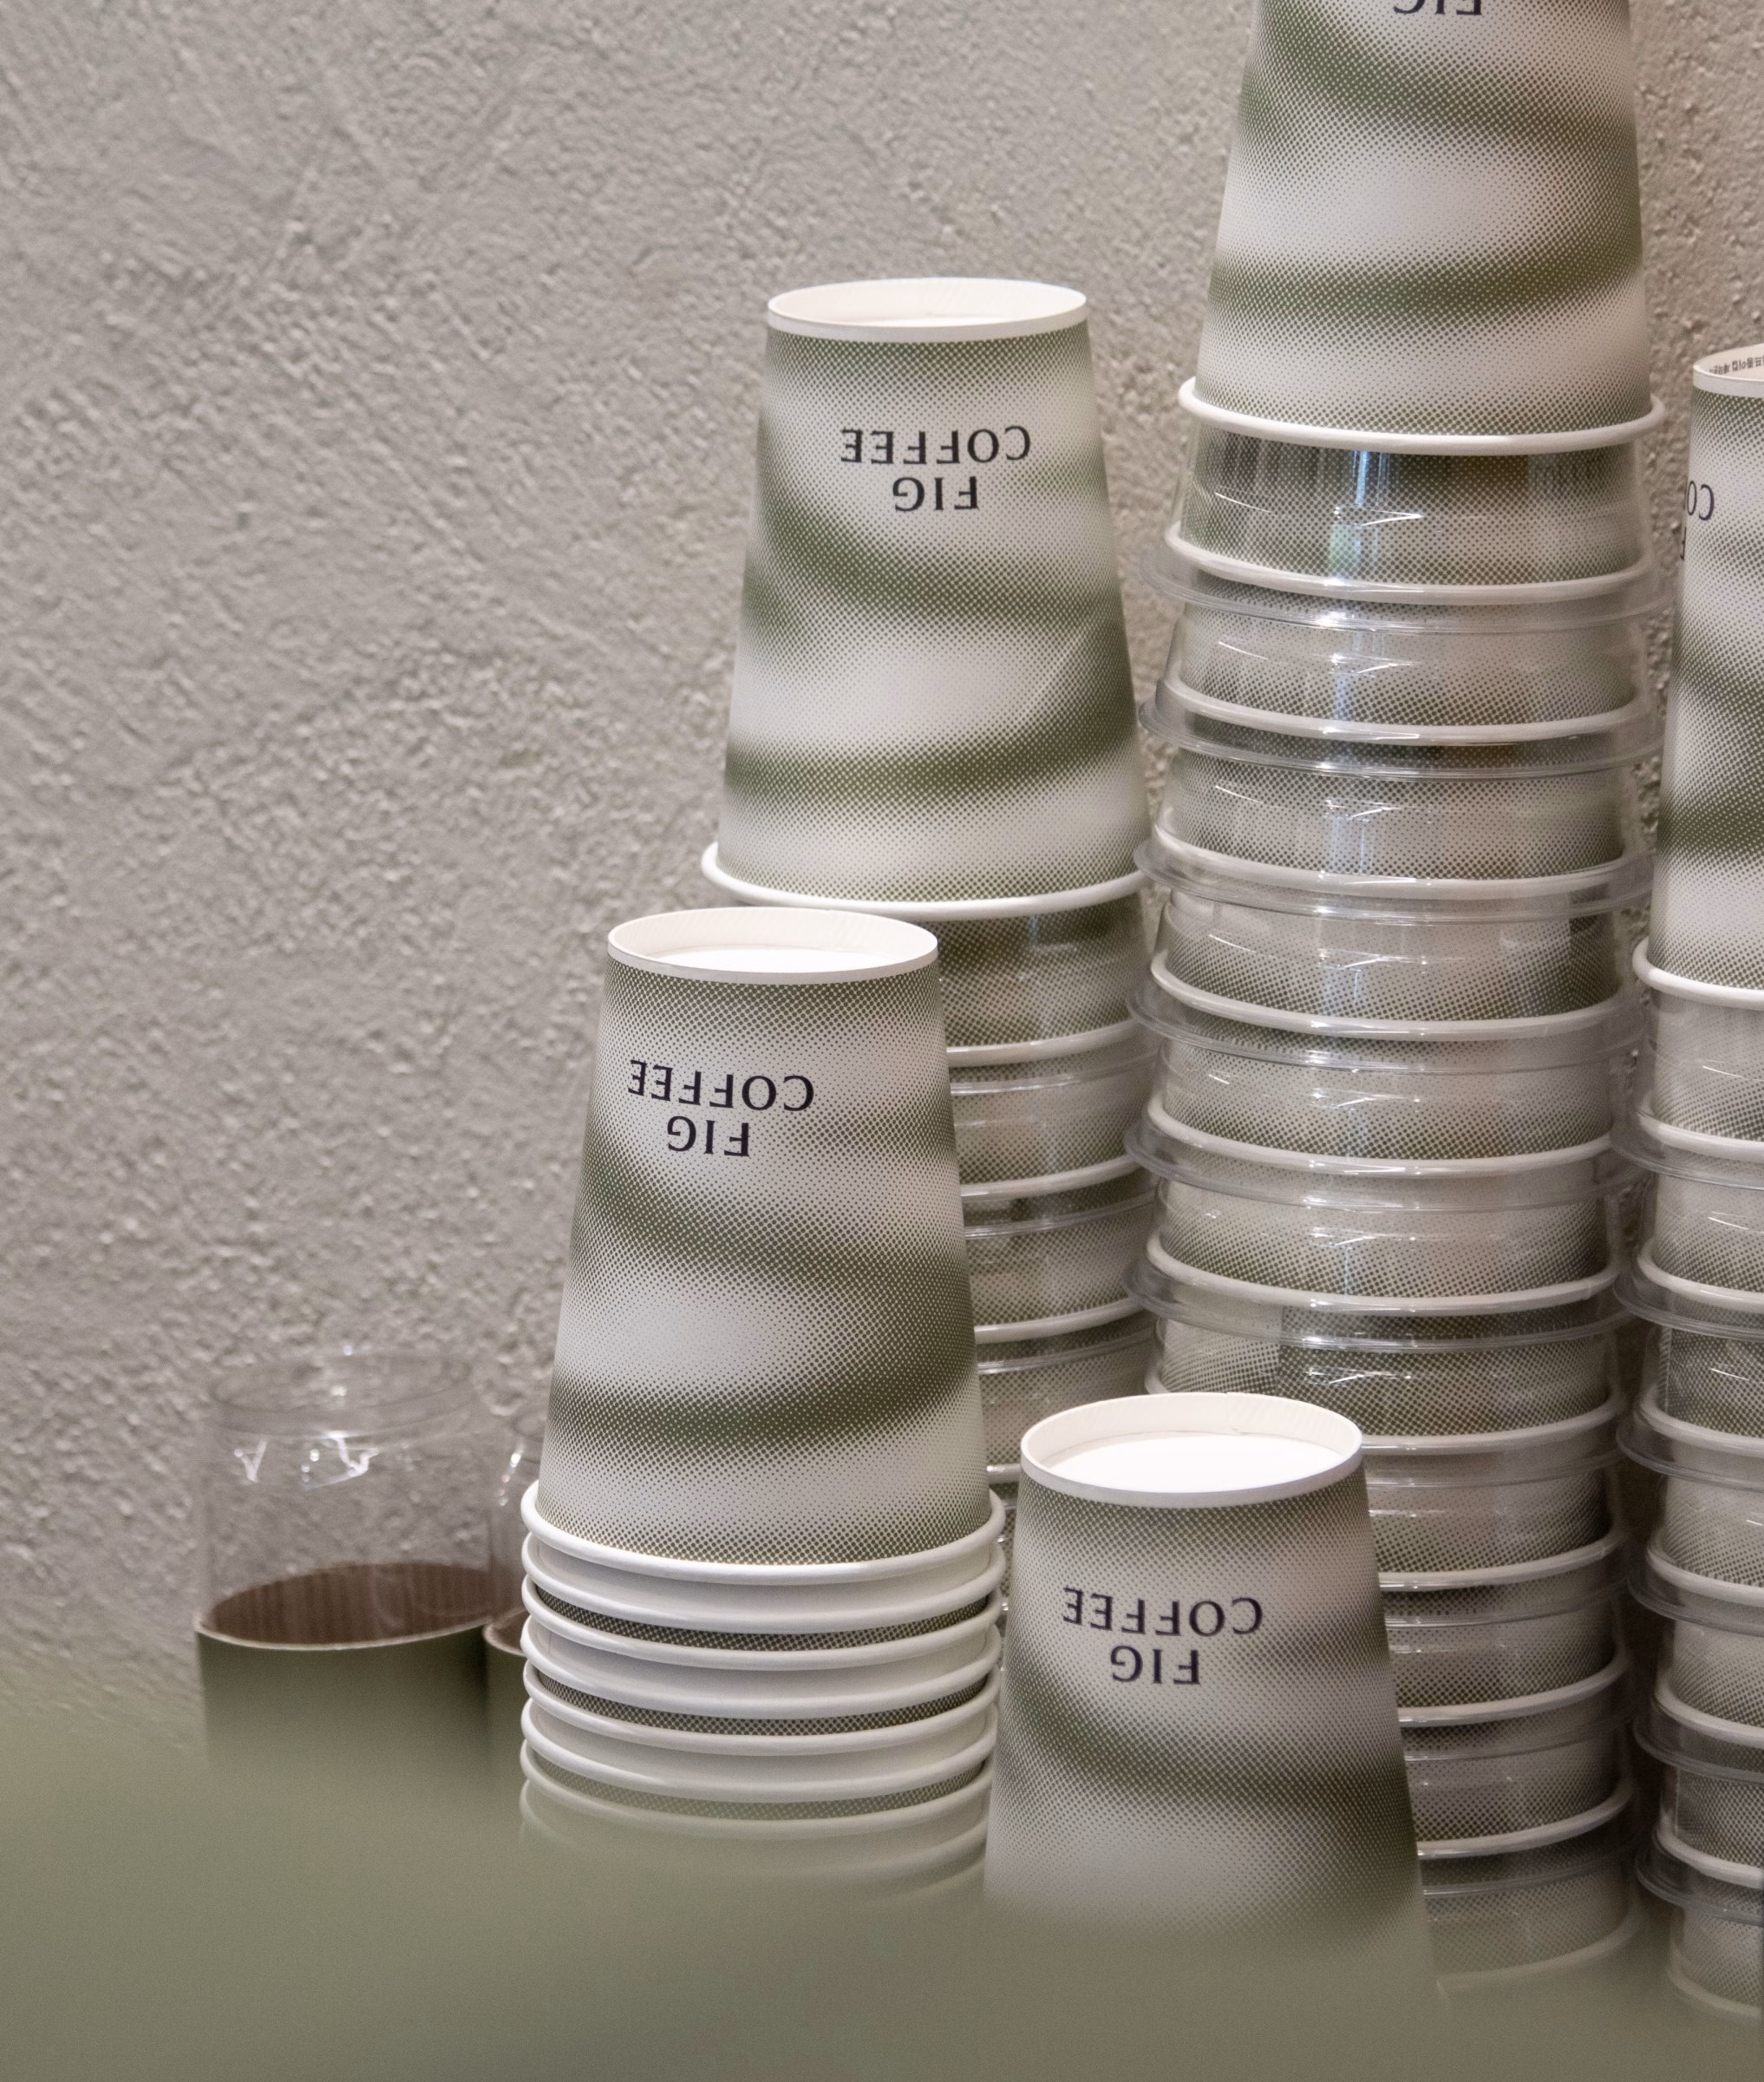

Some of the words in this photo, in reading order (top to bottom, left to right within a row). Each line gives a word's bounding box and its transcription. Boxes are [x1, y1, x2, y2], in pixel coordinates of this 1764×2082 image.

[840, 425, 1031, 465] COFFEE
[892, 476, 979, 512] FIG
[627, 1058, 814, 1111] COFFEE
[666, 1116, 750, 1157] FIG
[1062, 1586, 1264, 1638] COFFEE
[1109, 1645, 1201, 1685] FIG
